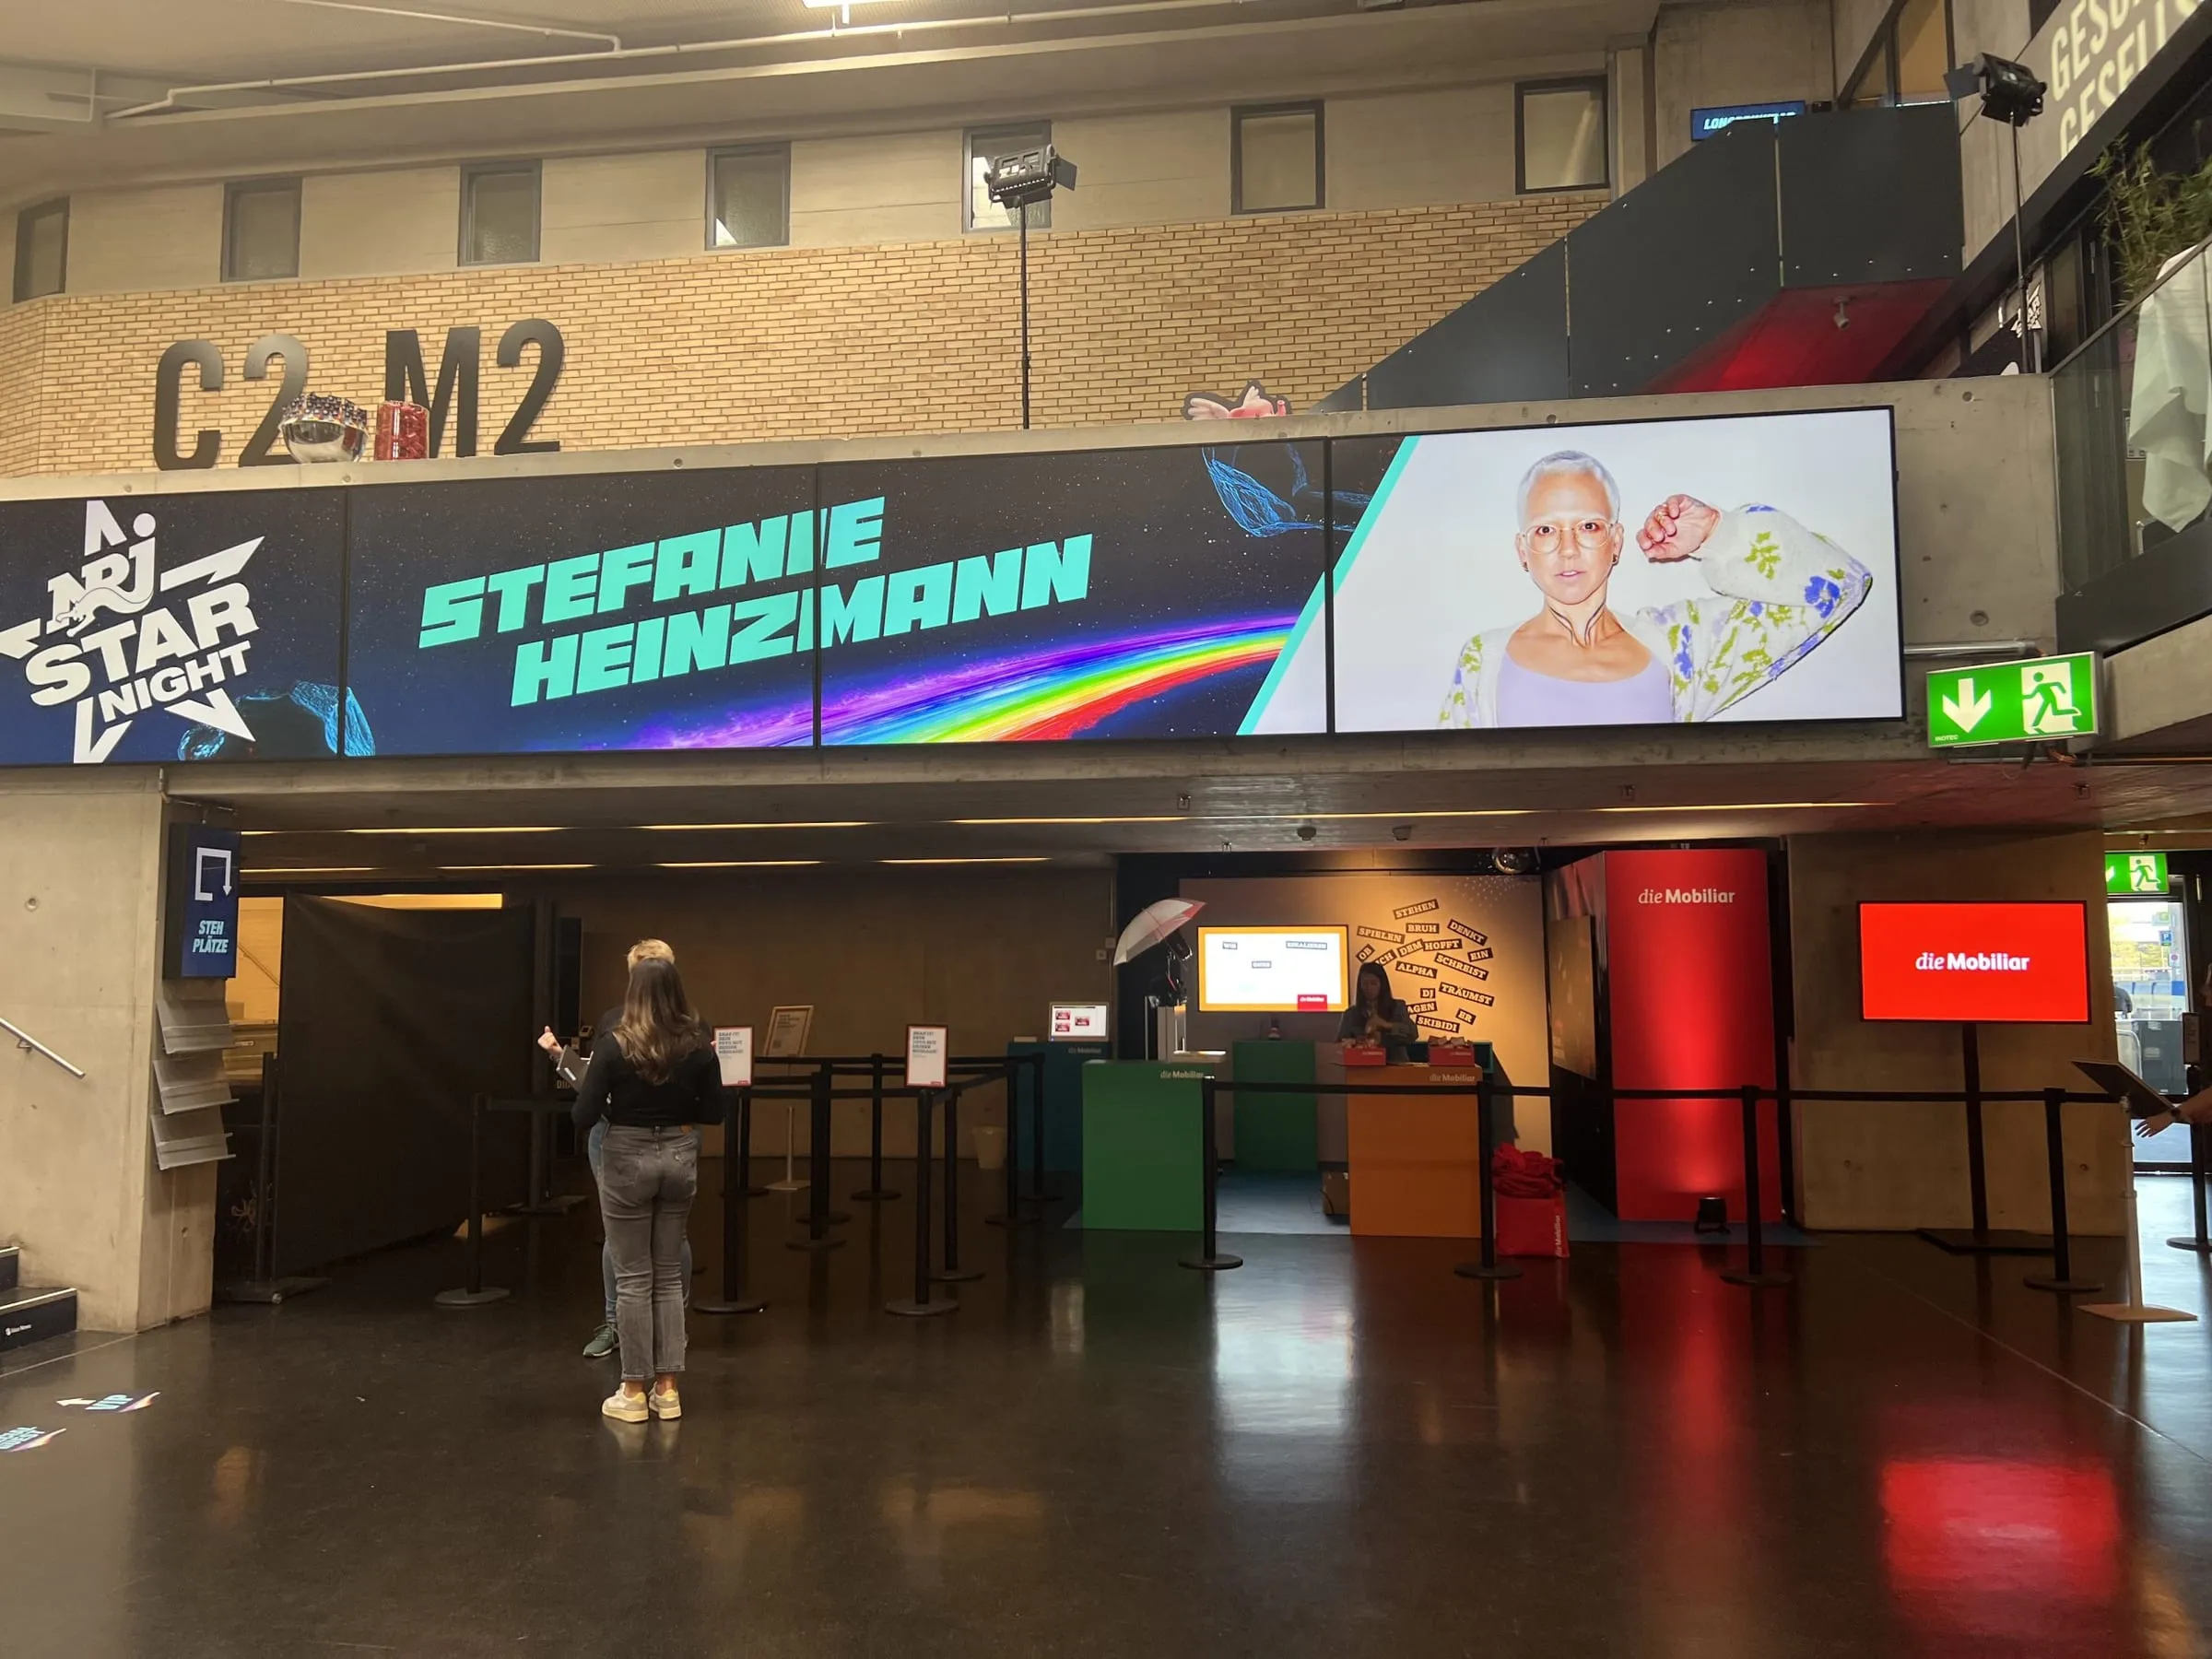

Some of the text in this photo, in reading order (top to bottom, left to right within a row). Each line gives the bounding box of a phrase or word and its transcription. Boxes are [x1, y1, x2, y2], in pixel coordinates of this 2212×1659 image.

[153, 318, 565, 471] C2 M2
[418, 496, 885, 649] STEFANIE
[511, 534, 1093, 708] HEINZMANN
[25, 582, 260, 707] STAR
[98, 640, 252, 723] NIGHT
[1638, 888, 1735, 904] die Mobiliar
[1394, 901, 1437, 918] STEHEN
[198, 920, 225, 935] STEH
[1359, 927, 1402, 943] SPIELEN
[1407, 924, 1437, 933] BRUH
[1449, 920, 1486, 944] DENKT
[192, 935, 229, 954] PLÄTZE
[1399, 940, 1423, 956] DEM
[1424, 940, 1460, 950] HOFFT
[1359, 947, 1372, 960] OB
[1469, 950, 1490, 961] EIN
[1915, 952, 2030, 971] die Mobiliar
[1397, 963, 1435, 977] ALPHA
[1436, 954, 1487, 979] SCHREIST
[1422, 989, 1434, 998] DJ
[1441, 982, 1492, 1005] TRÄUMST
[1417, 1017, 1458, 1031] SKIBIDI
[1457, 1011, 1474, 1023] ER
[1442, 1074, 1476, 1082] Mobiliar
